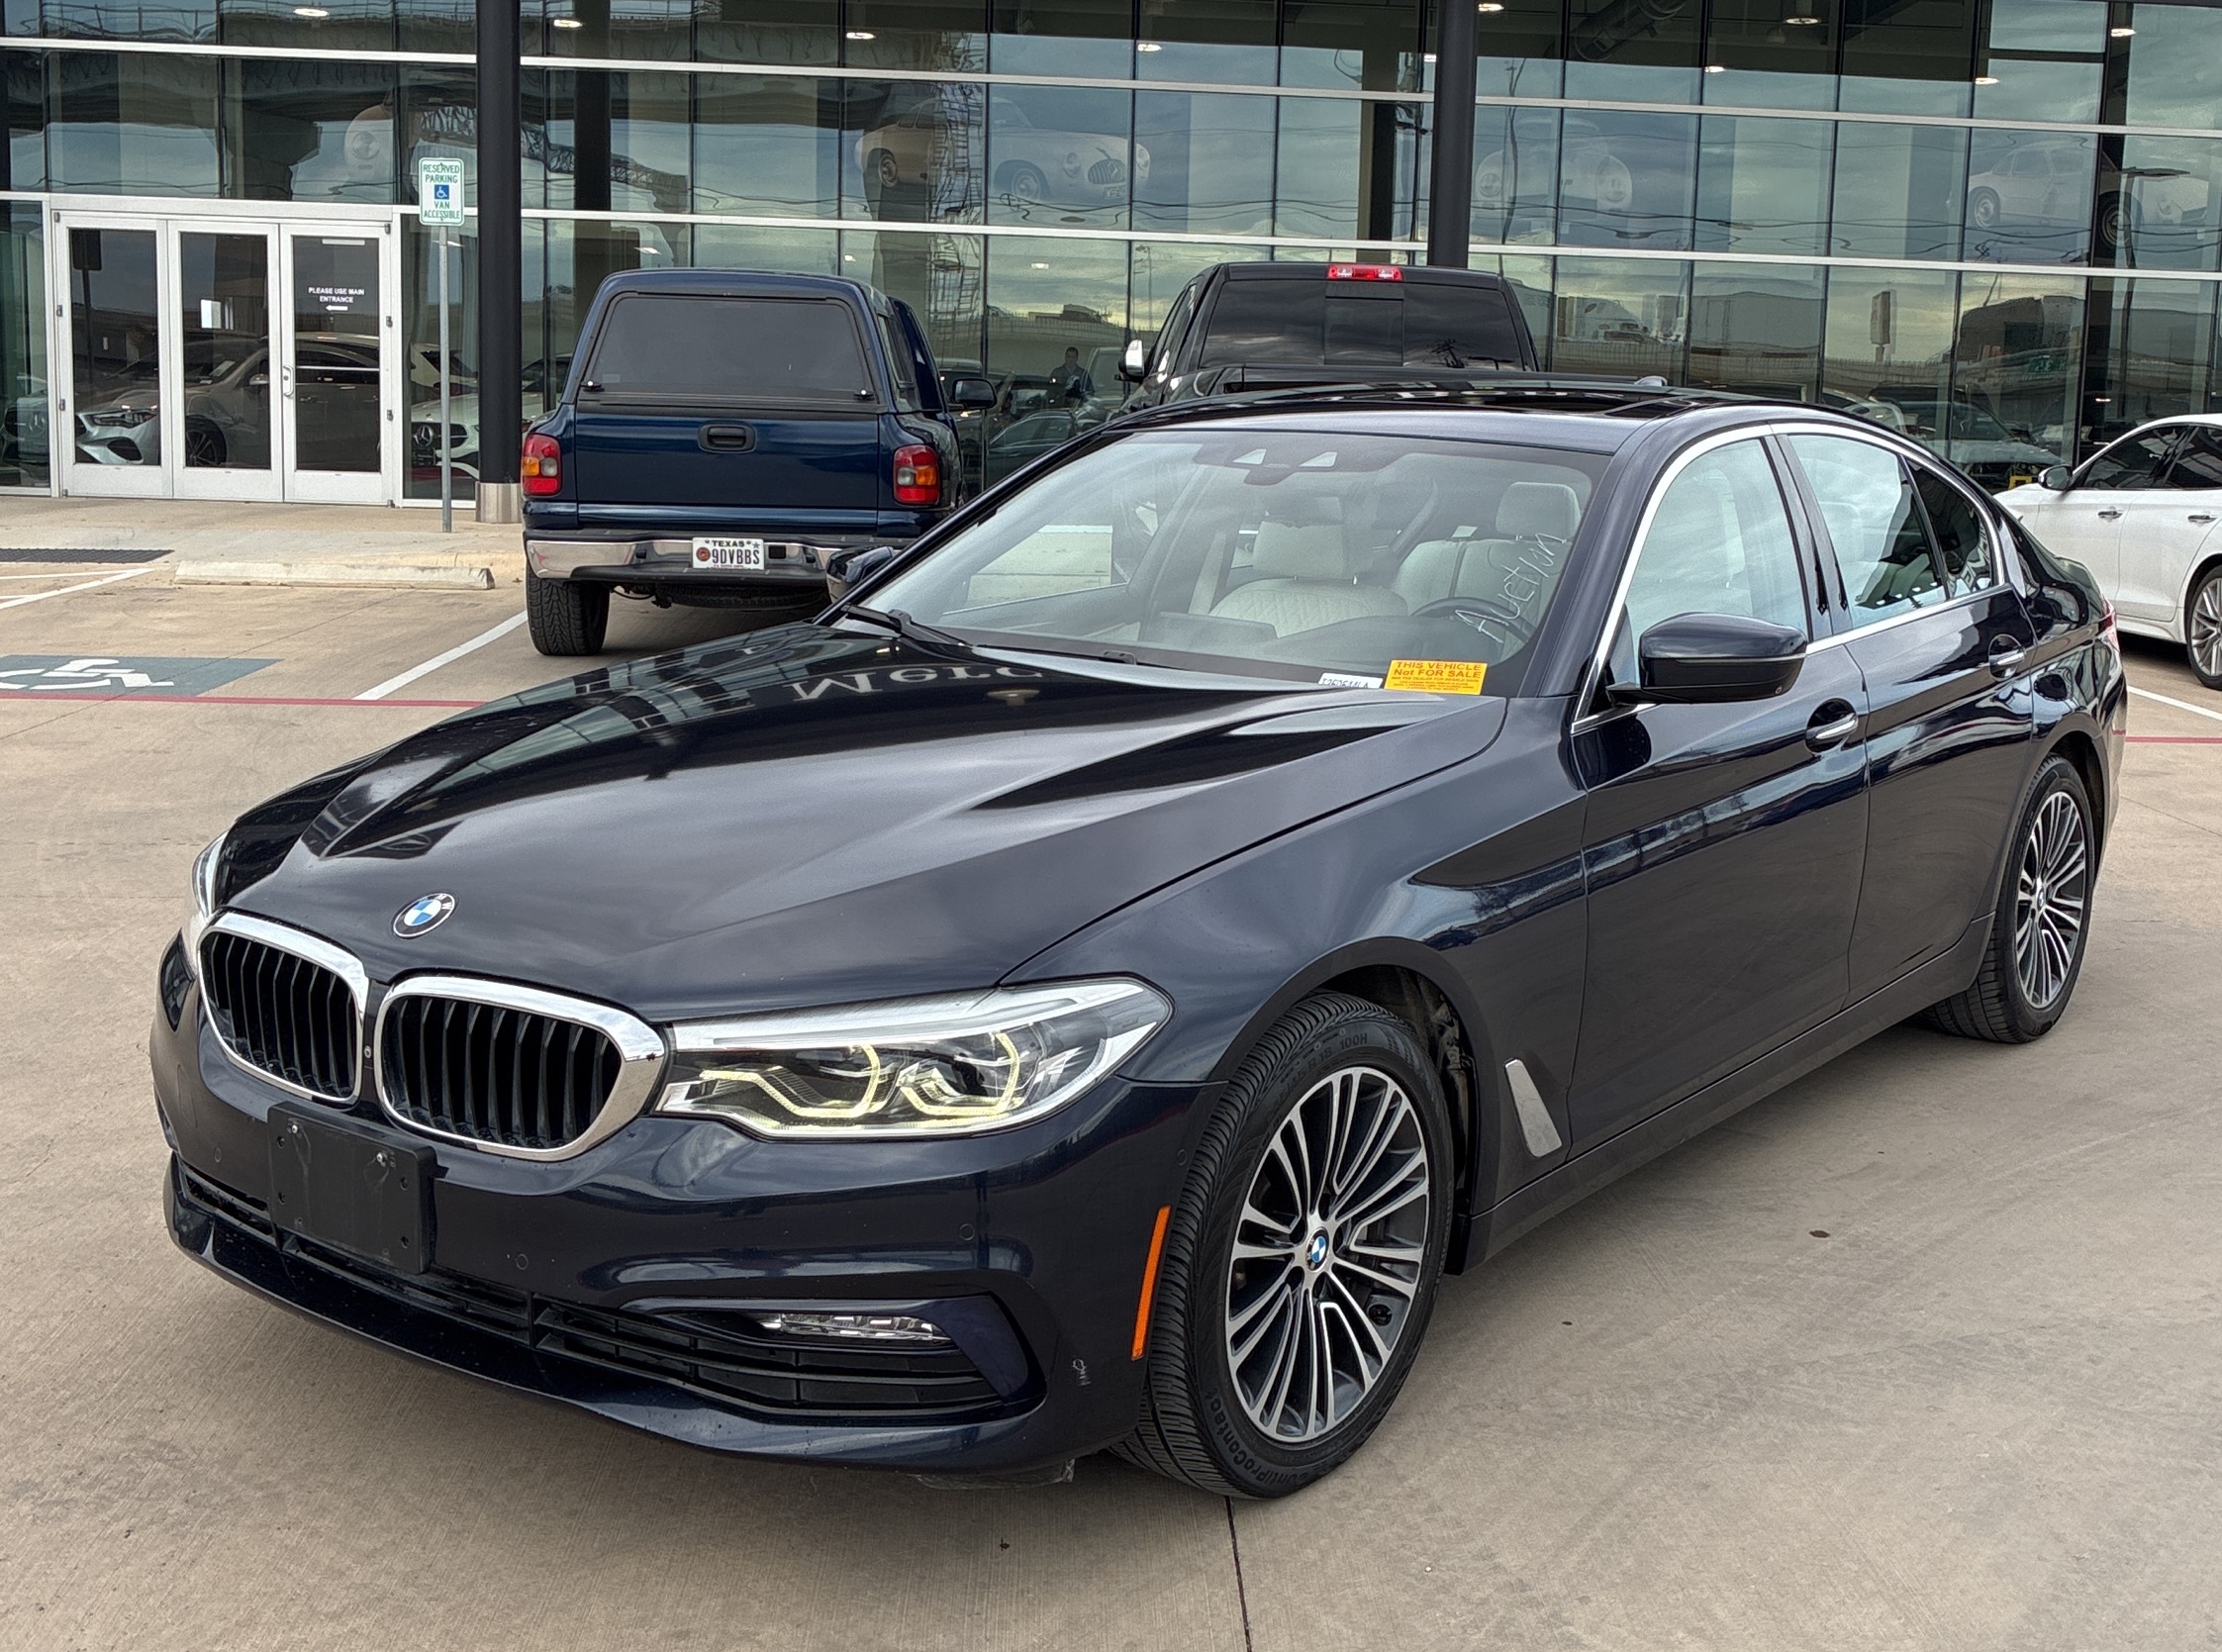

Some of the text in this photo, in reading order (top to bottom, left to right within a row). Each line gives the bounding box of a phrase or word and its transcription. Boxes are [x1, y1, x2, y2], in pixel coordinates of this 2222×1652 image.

[423, 164, 460, 173] RESERVED
[425, 174, 458, 183] PARKING
[424, 210, 460, 219] ACCESSIBLE
[1339, 1032, 1368, 1050] 100H
